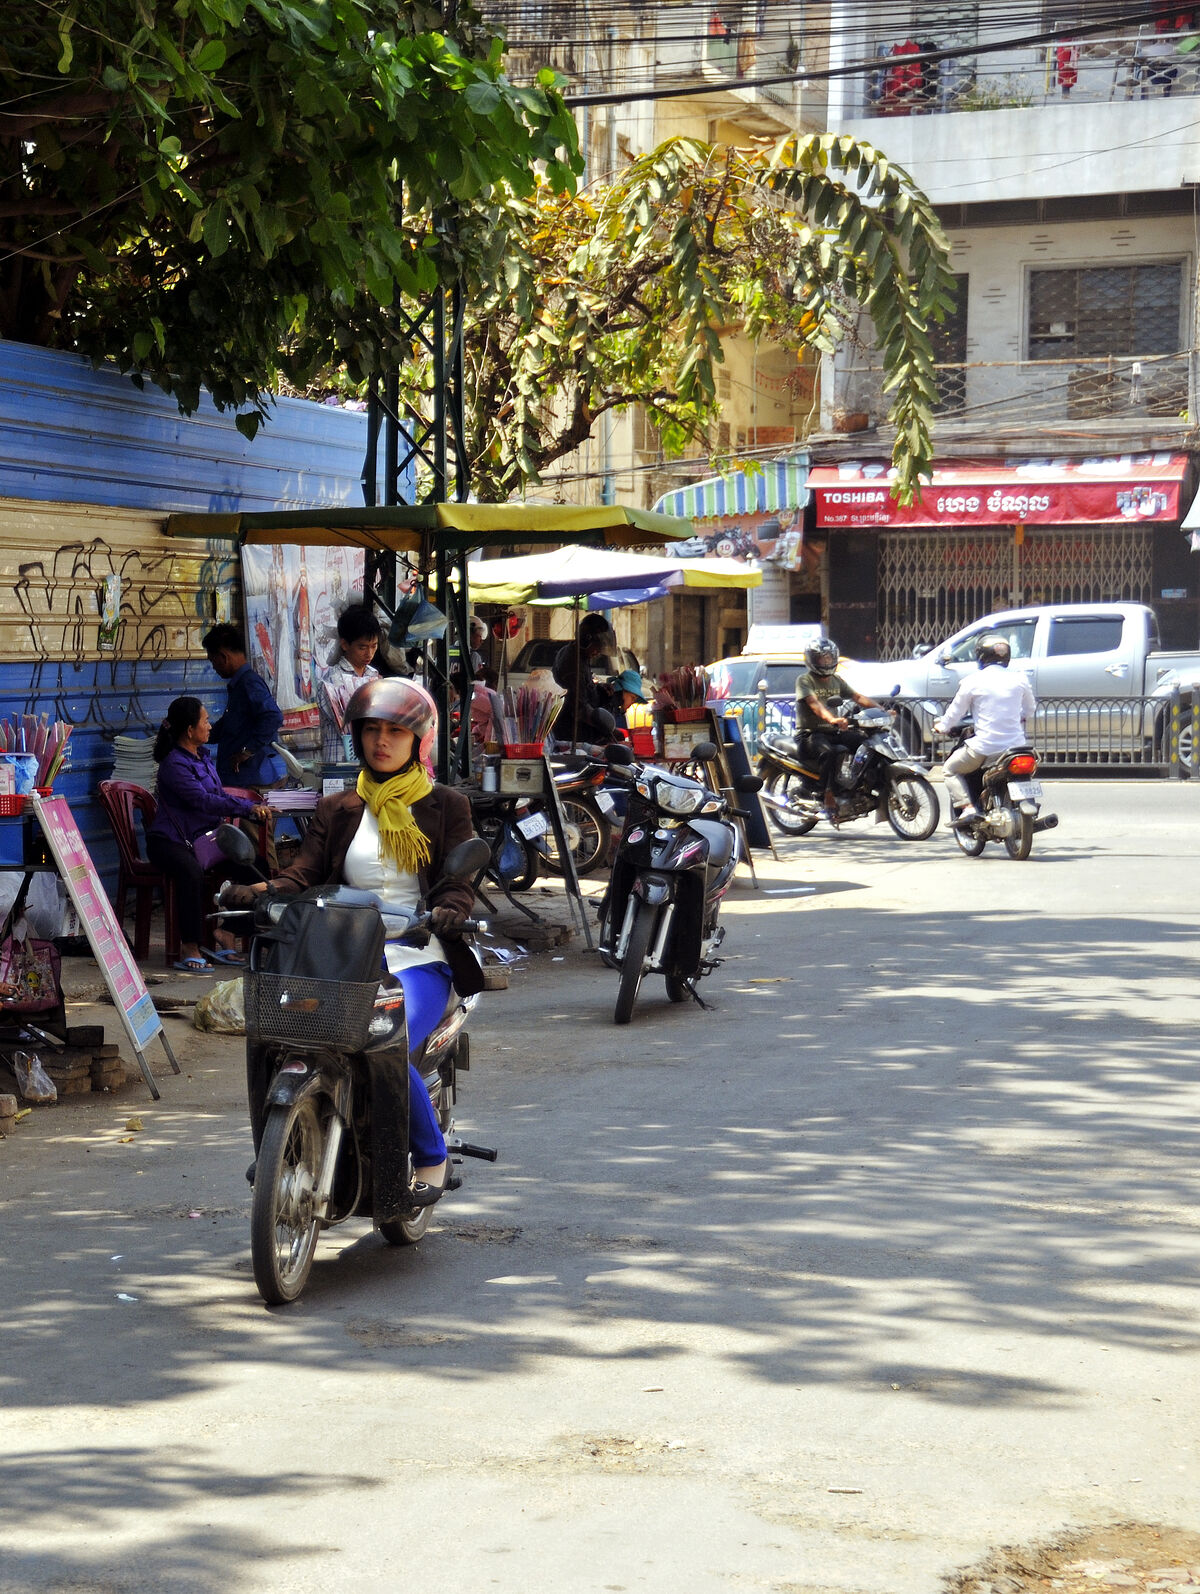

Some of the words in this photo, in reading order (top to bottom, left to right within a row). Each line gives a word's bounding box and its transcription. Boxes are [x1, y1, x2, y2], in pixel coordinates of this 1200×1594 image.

[823, 492, 885, 504] TOSHIBA
[936, 496, 980, 513] ហេង
[986, 490, 1050, 518] ចំណូល
